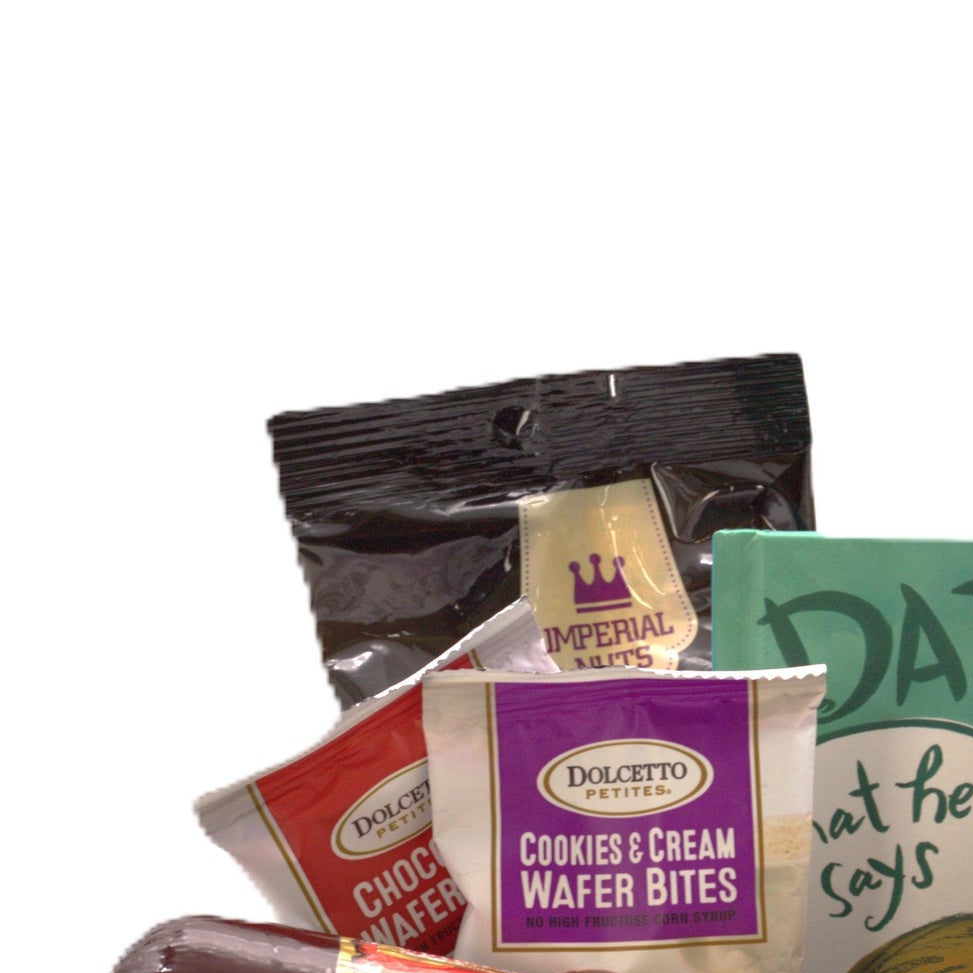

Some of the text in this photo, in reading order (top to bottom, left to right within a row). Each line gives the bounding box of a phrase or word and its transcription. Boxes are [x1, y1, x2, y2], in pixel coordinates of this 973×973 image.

[544, 611, 675, 654] IMPERIAL
[566, 762, 688, 787] DOLCETTO
[376, 799, 432, 839] PETIT
[520, 826, 736, 866] COOKIES & CREAM
[520, 867, 738, 909] WAFER BITES
[820, 842, 939, 931] says
[526, 916, 544, 928] NO
[549, 916, 579, 928] HIGH
[584, 914, 649, 928] FRUCTOSE
[693, 910, 736, 924] SYRUP
